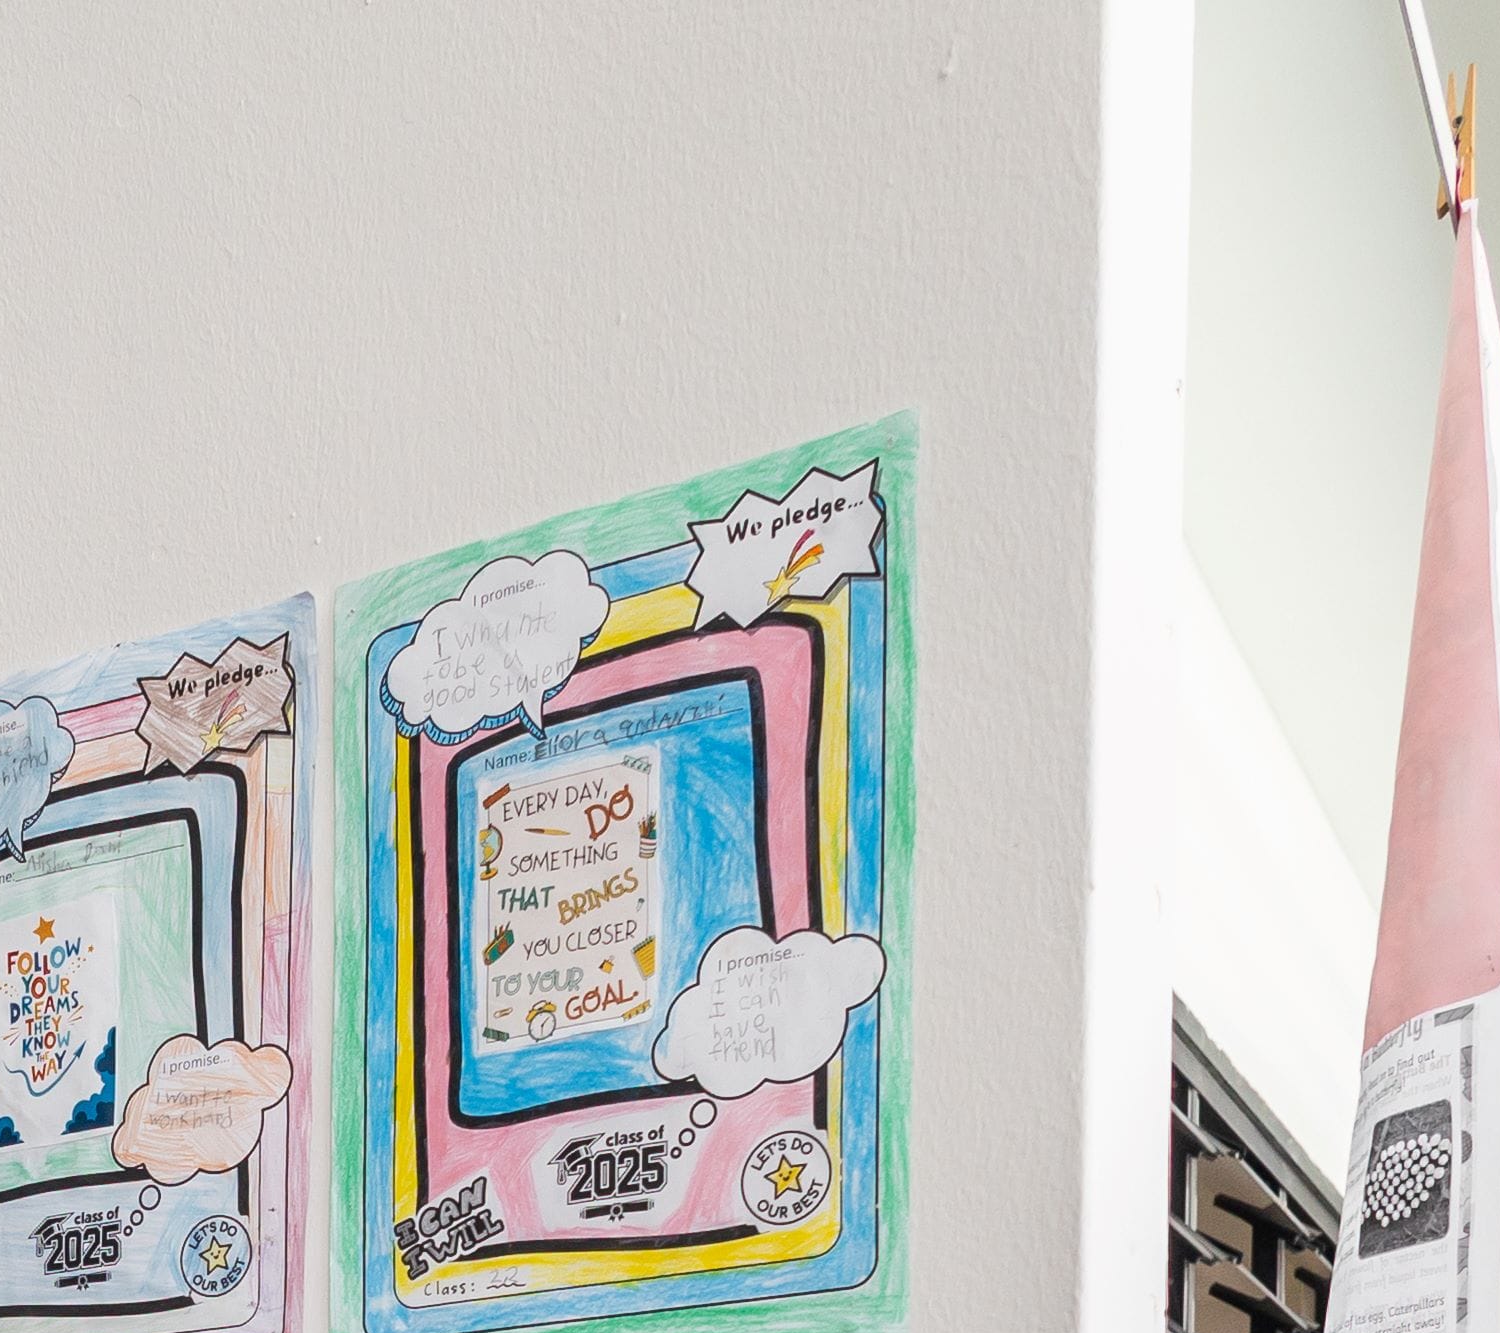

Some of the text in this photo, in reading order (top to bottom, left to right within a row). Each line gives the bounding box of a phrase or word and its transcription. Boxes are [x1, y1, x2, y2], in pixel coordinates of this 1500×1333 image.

[727, 497, 864, 545] We pledge...
[168, 665, 278, 699] We pledge...
[503, 779, 608, 823] EVERY DAY,
[585, 785, 634, 840] DO
[508, 843, 619, 877] SOMETHING
[498, 867, 638, 925] THAT BRINGS
[7, 937, 81, 976] FOLLOW
[523, 922, 638, 960] YOU CLOSER
[22, 975, 69, 998] YOUR
[492, 966, 584, 996] TO YOUR
[10, 991, 79, 1024] DREAMS
[25, 1015, 61, 1034] THEY
[22, 1032, 70, 1053] KNOW
[31, 1050, 66, 1083] WAY
[606, 1124, 665, 1146] class of
[751, 1138, 814, 1172] LET'S DO
[568, 1145, 668, 1204] 2025
[397, 1178, 488, 1249] I CAN
[758, 1179, 824, 1220] OUR BEST
[44, 1224, 122, 1275] 2025
[403, 1211, 503, 1278] I WILL
